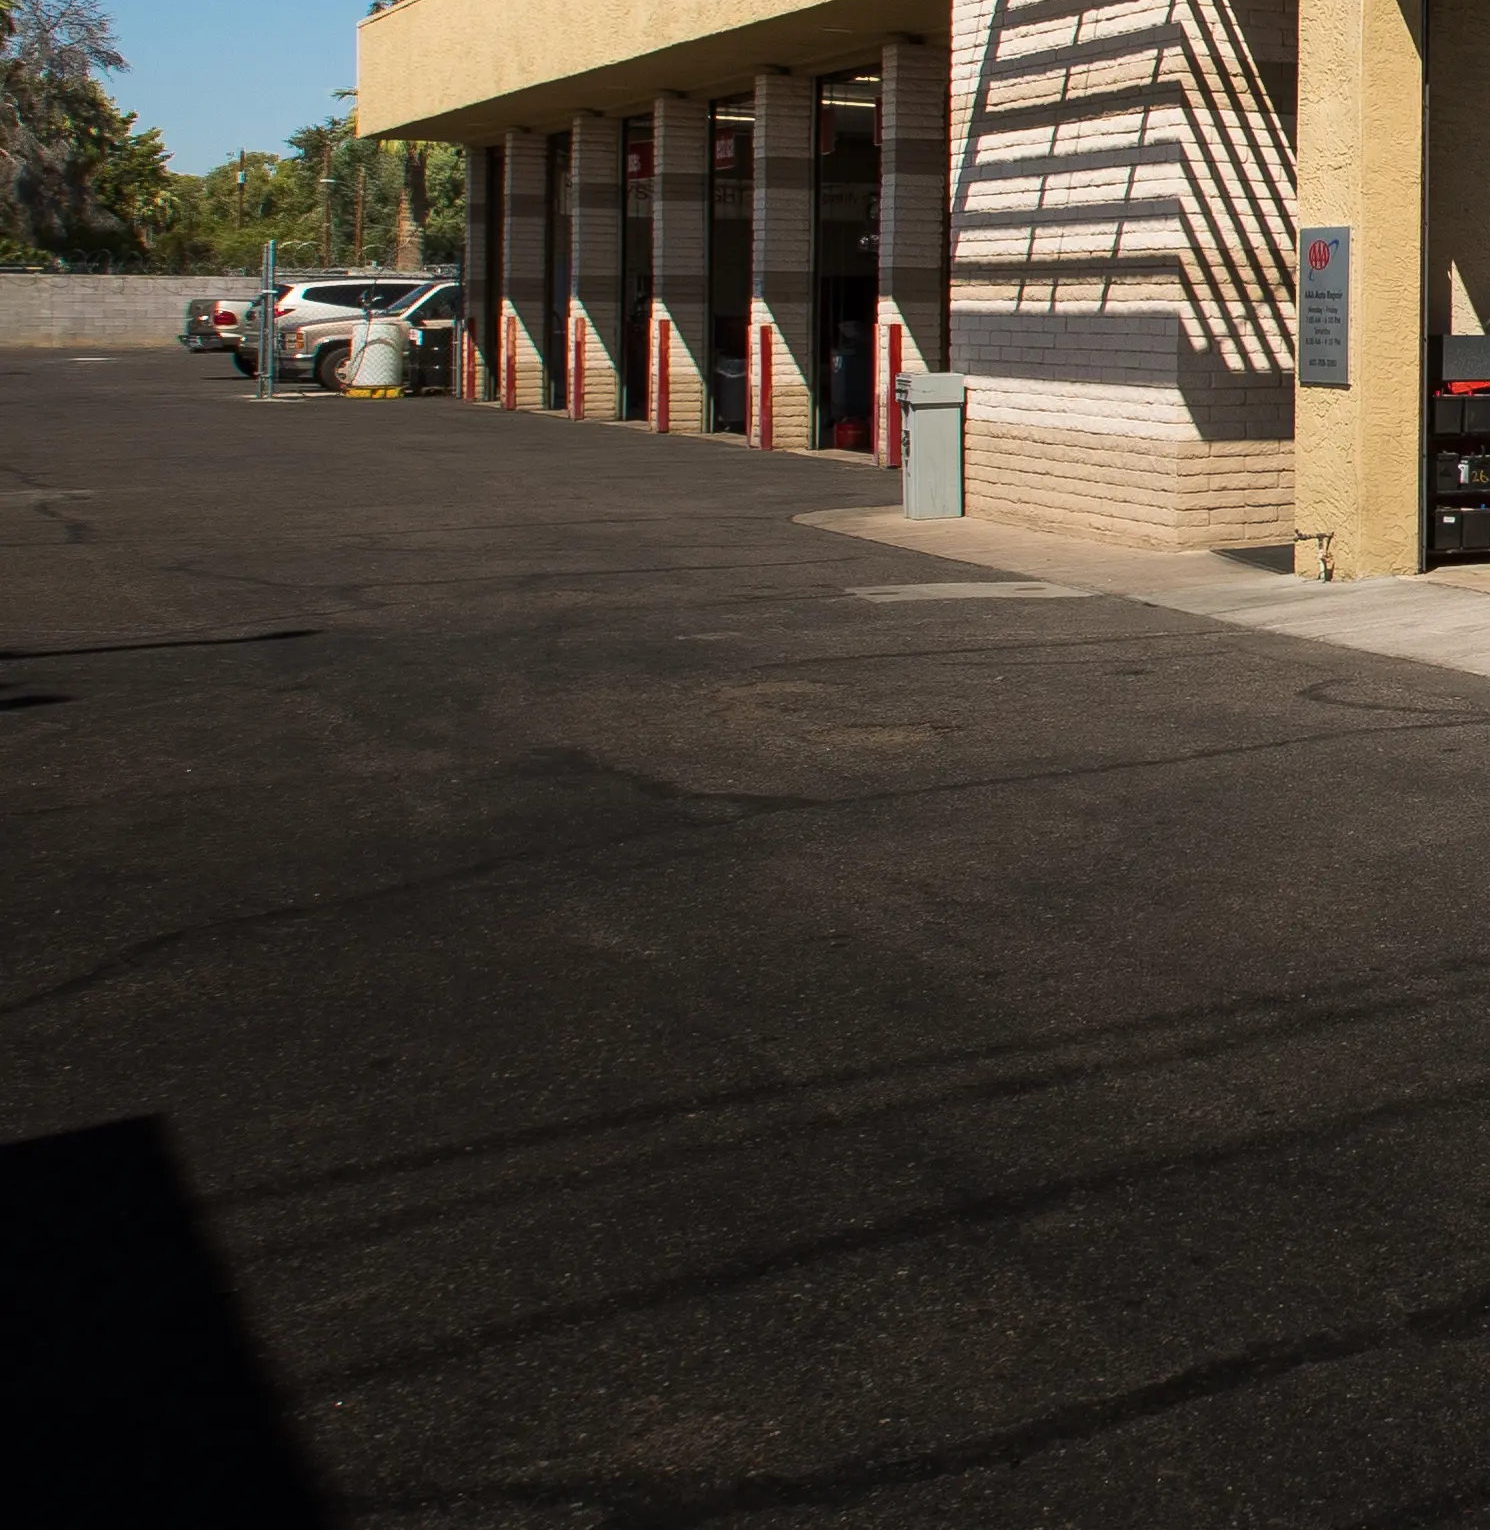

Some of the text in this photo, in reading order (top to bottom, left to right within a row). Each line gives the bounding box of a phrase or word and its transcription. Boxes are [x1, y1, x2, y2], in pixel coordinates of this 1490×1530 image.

[1308, 241, 1329, 270] AAA
[1315, 290, 1326, 299] Auto
[1327, 290, 1343, 301] Repair
[1471, 470, 1489, 484] 26
